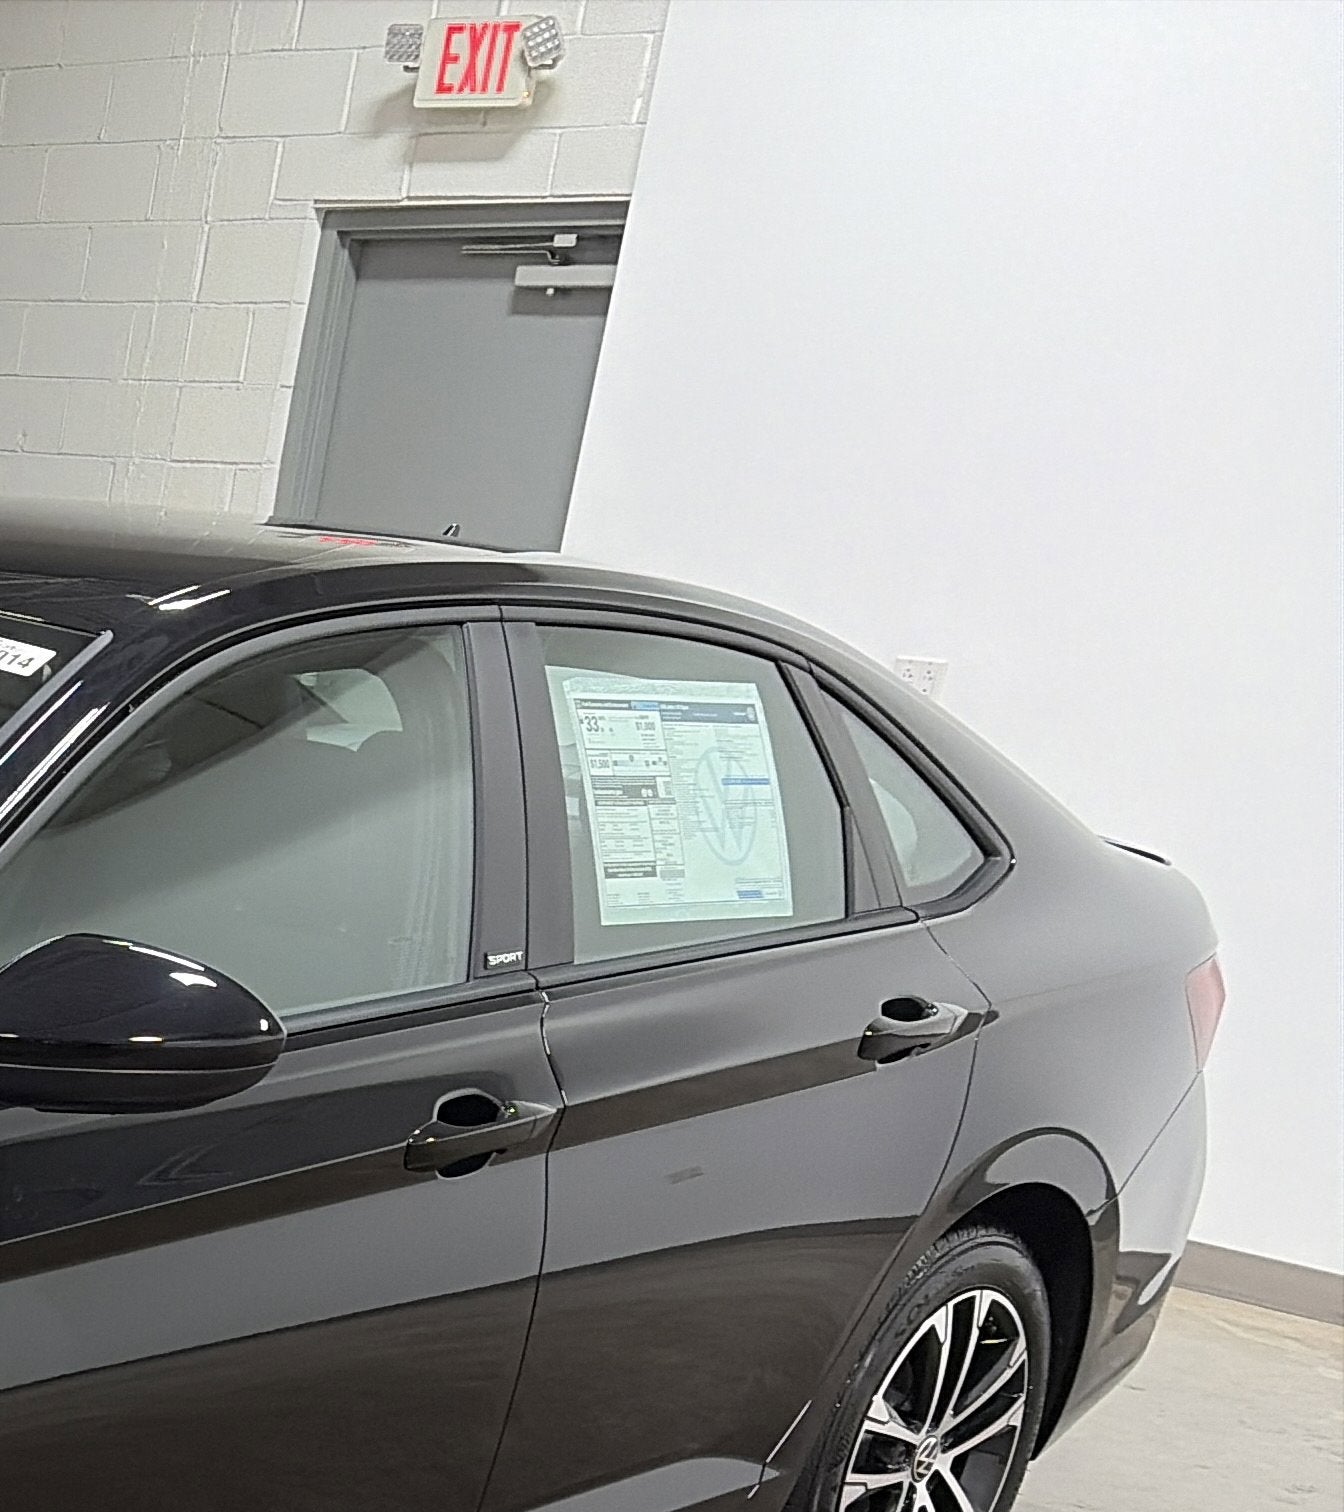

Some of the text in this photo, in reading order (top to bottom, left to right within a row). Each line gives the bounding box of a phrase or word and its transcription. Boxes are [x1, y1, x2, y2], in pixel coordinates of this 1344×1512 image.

[434, 21, 523, 95] EXIT
[584, 715, 599, 732] 33
[487, 950, 524, 966] SPORT
